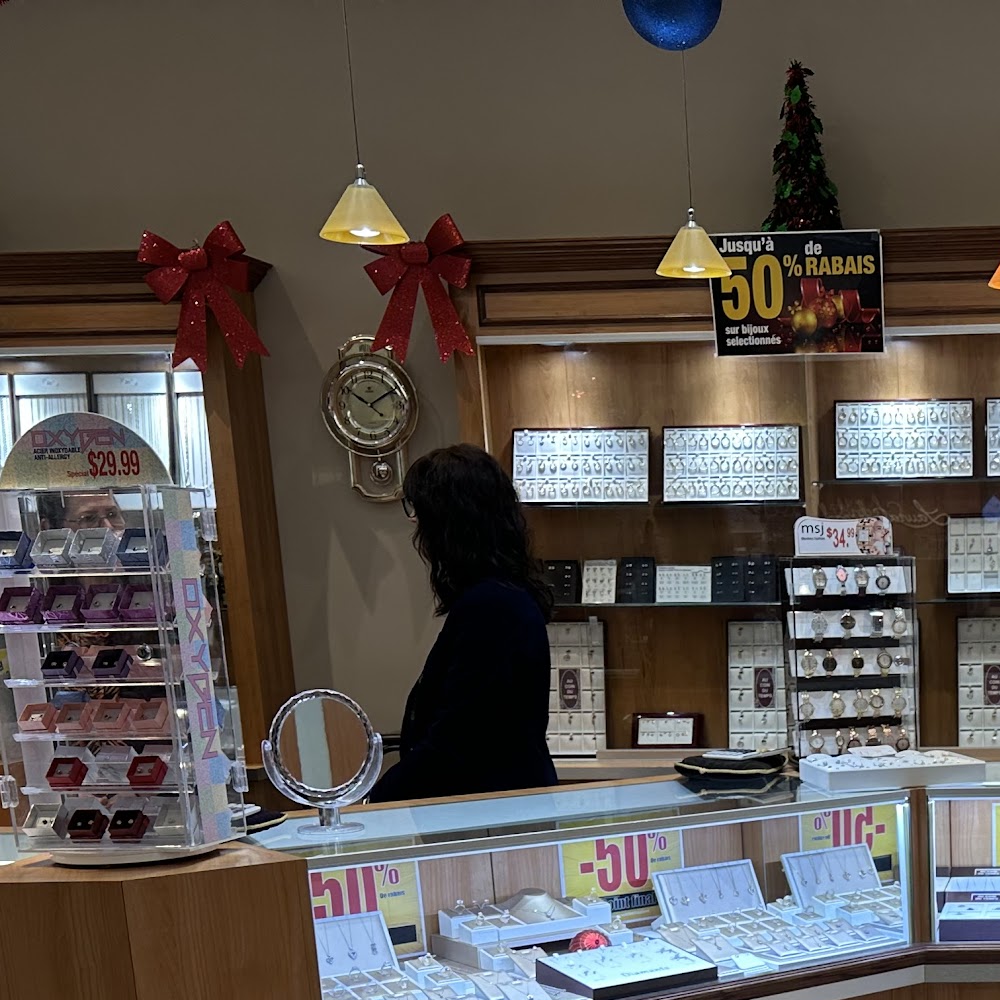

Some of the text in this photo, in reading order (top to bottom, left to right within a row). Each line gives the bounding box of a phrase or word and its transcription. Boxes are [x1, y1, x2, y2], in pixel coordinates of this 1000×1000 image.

[719, 237, 822, 255] Jusqu'à de
[805, 255, 875, 276] RABAIS
[725, 324, 769, 336] sur bijoux
[88, 449, 140, 478] $29.99
[801, 523, 825, 536] msj
